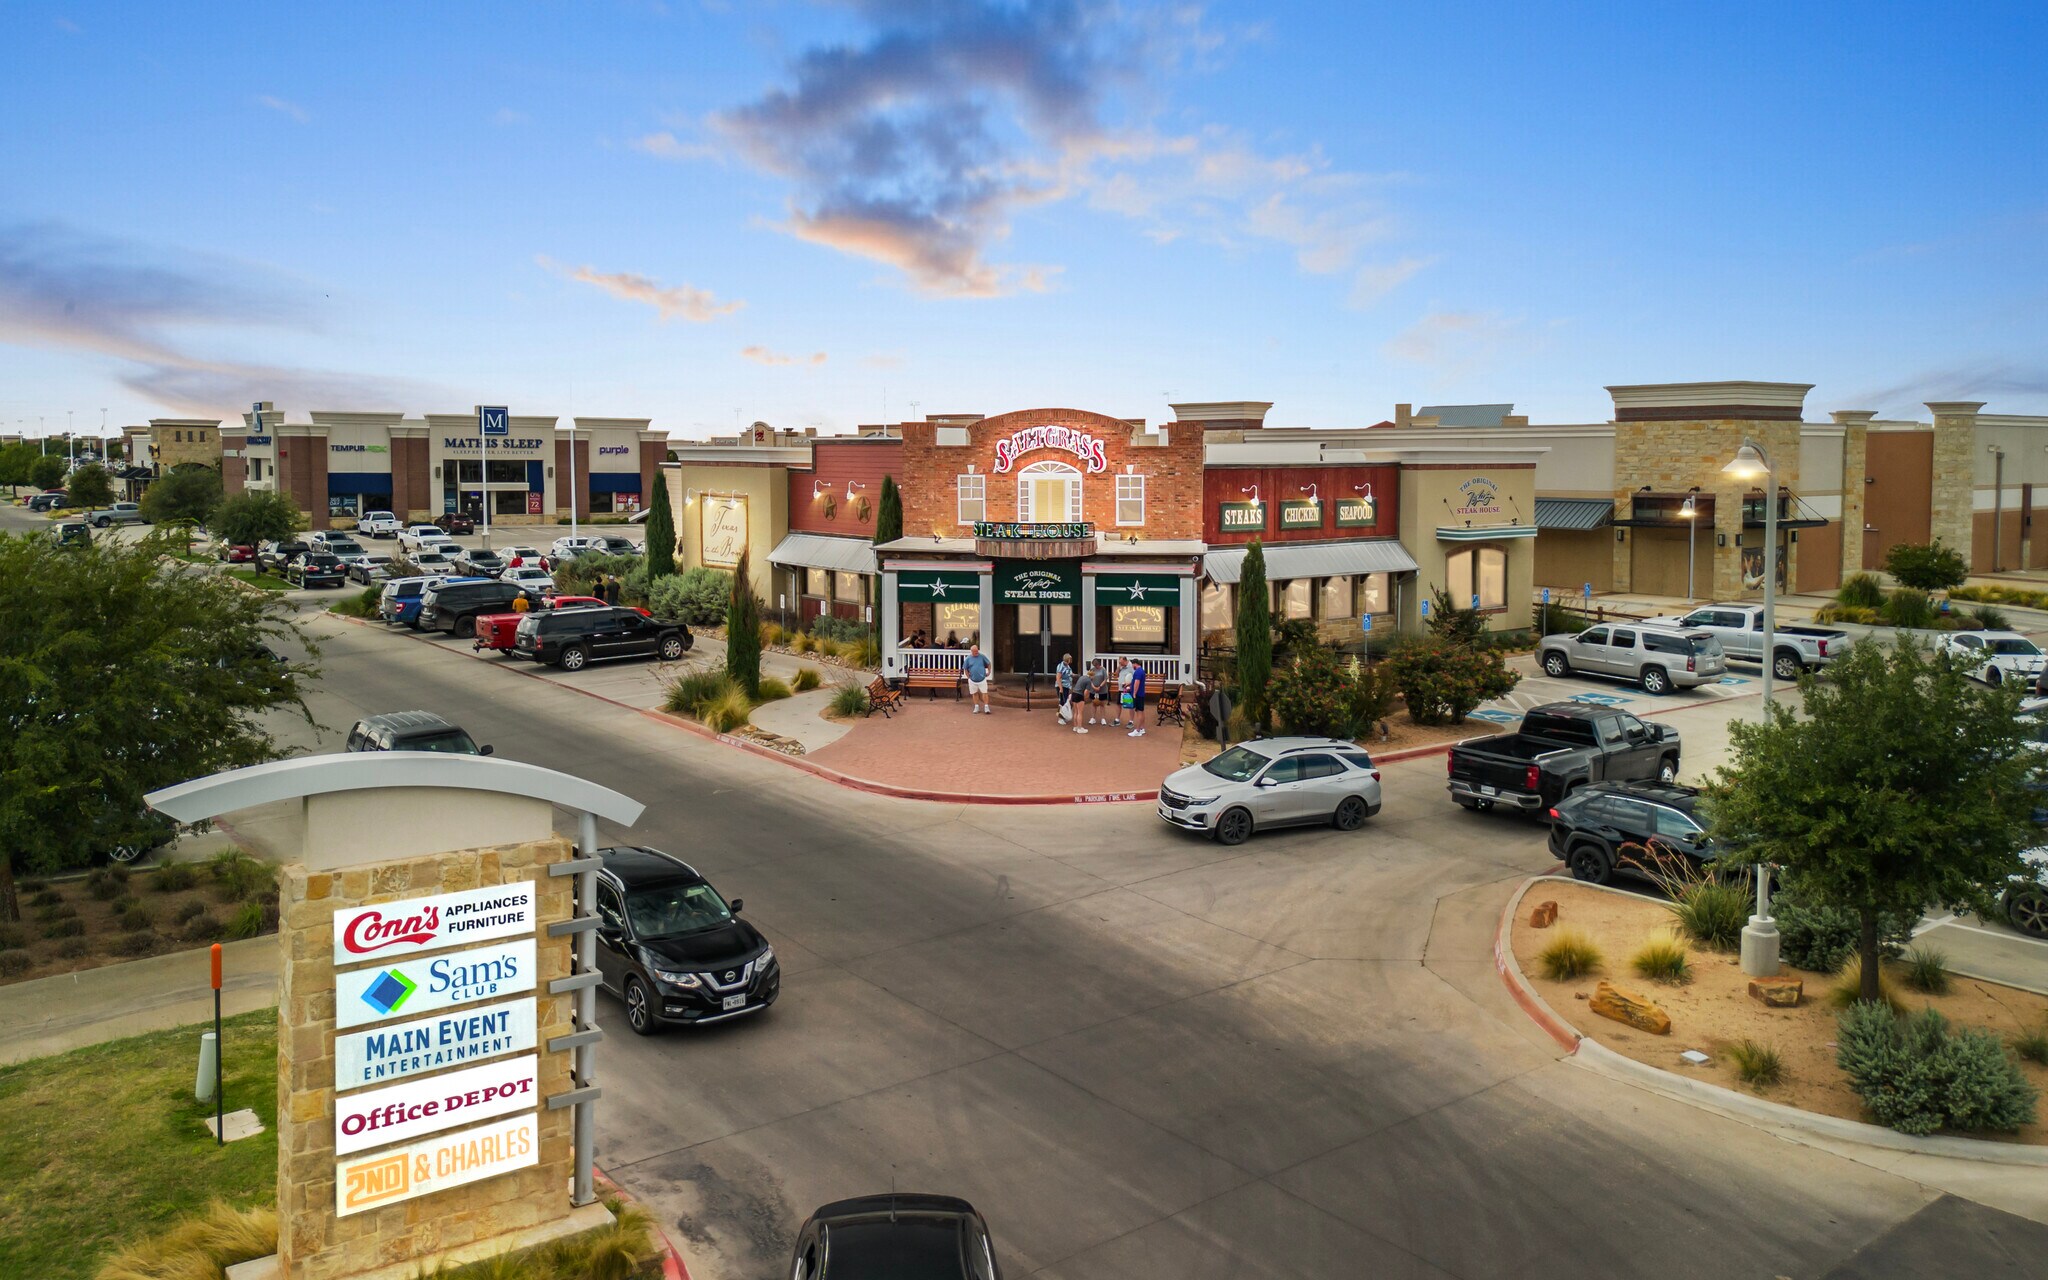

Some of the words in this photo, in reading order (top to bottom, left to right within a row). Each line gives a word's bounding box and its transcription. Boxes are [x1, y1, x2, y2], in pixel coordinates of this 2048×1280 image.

[486, 414, 503, 428] M
[503, 438, 543, 449] SLEEP
[599, 445, 629, 455] purple
[993, 425, 1107, 473] SALTGRASS
[1459, 481, 1470, 492] THE
[1472, 477, 1498, 492] ORIGINAL
[711, 505, 738, 537] Texas
[1224, 508, 1262, 525] STEAKS
[1284, 506, 1319, 523] CHICKEN
[1339, 505, 1373, 521] SEAFOOD
[973, 522, 1020, 537] STEAK
[1032, 523, 1089, 537] HOUSE
[1014, 572, 1028, 581] THE
[1029, 570, 1061, 582] ORIGINAL
[445, 894, 528, 917] APPLIANCES
[343, 905, 439, 953] Conn's
[448, 911, 525, 933] FURNITURE
[429, 954, 517, 993] Sam's
[451, 983, 497, 1001] CLUB
[366, 1027, 430, 1062] MAIN
[439, 1010, 510, 1046] EVENT
[364, 1035, 513, 1081] ENTERTAINMENT
[341, 1101, 439, 1136] Office
[444, 1077, 533, 1112] DEPOT
[346, 1157, 405, 1209] 2ND
[414, 1153, 431, 1183] &
[436, 1126, 530, 1178] CHARLES
